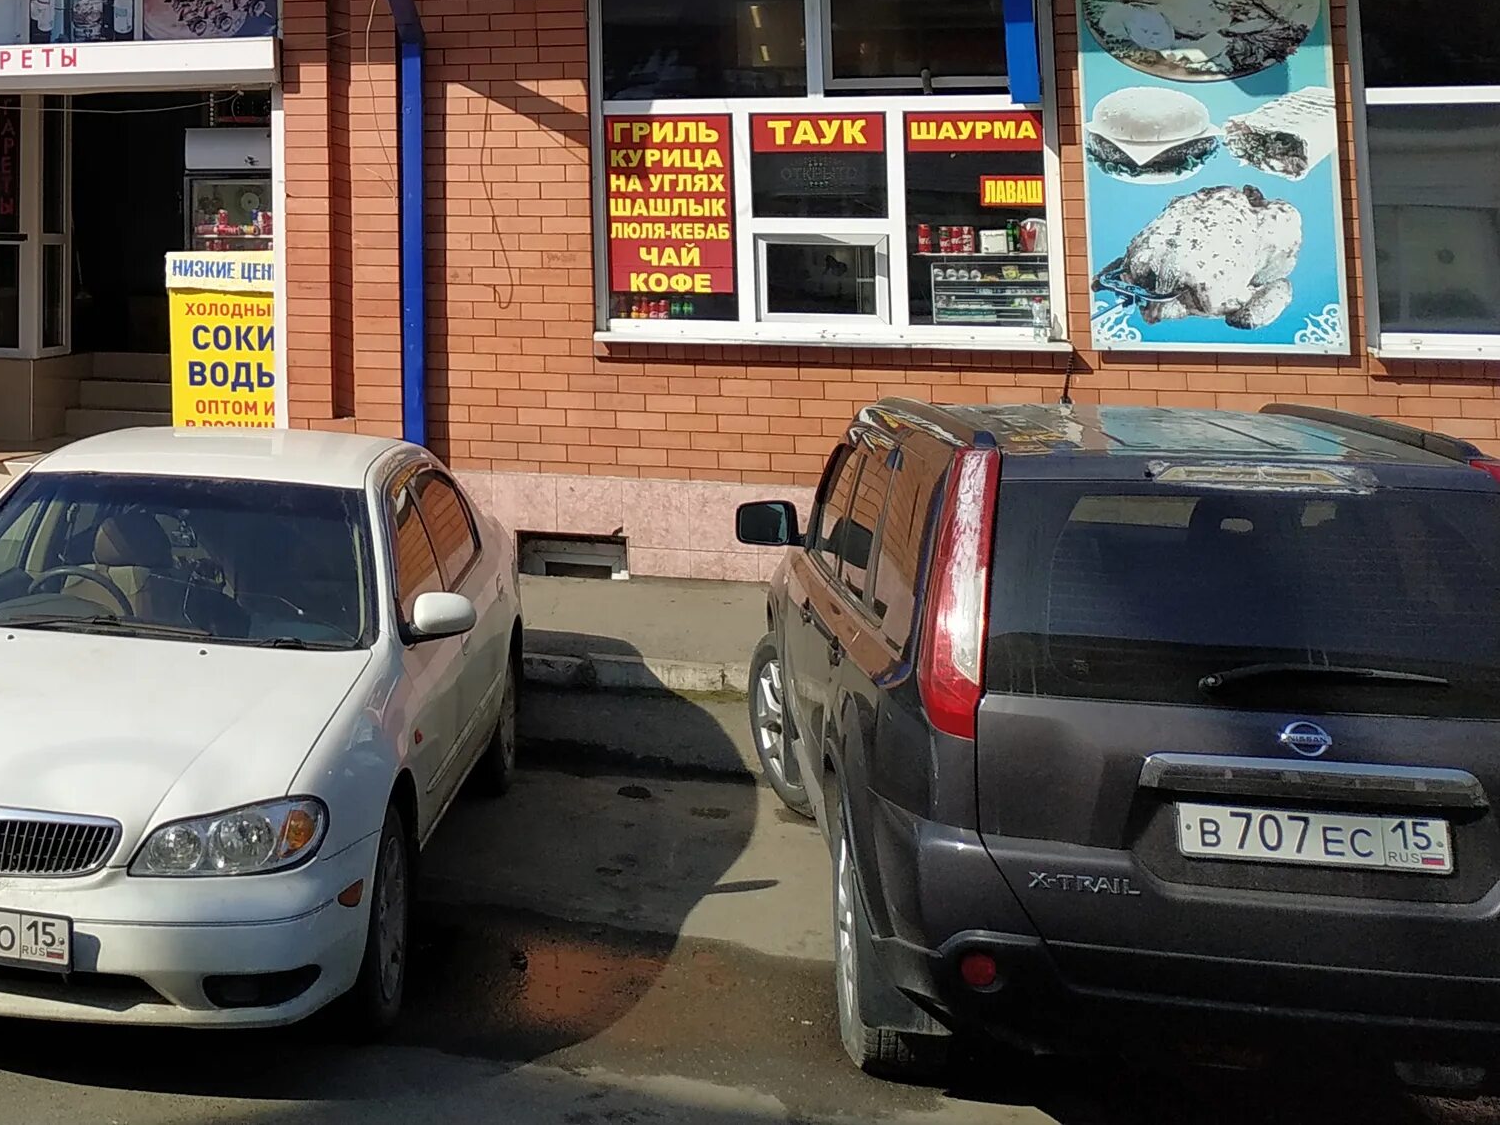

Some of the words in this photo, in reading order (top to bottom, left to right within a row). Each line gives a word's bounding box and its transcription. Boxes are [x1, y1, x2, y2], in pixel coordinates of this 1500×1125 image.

[613, 121, 720, 144] ГРИЛЬ
[767, 119, 867, 146] ТАУК
[910, 120, 1038, 141] ШАУРМА
[610, 149, 724, 171] КУРИЦА
[609, 174, 643, 192] НА
[650, 174, 726, 192] УГЛЯХ
[984, 179, 1043, 204] ЛАВАШ
[609, 198, 727, 217] ШАШЛЫК
[610, 222, 730, 240] ЛЮЛЯ-КЕБАБ
[639, 242, 701, 267] ЧАЙ
[172, 259, 236, 279] НИЗКИЕ
[241, 261, 274, 283] ЦЕН
[630, 272, 713, 293] КОФЕ
[184, 302, 274, 319] ХОЛОДНЫ
[192, 325, 275, 352] СОКИ
[195, 399, 258, 416] ОПТОМ
[264, 401, 275, 416] И
[1390, 820, 1432, 851] 15
[1388, 851, 1420, 864] RUS
[1028, 871, 1141, 896] X-TRAIL
[26, 920, 56, 947] 15
[22, 945, 46, 957] RUS
